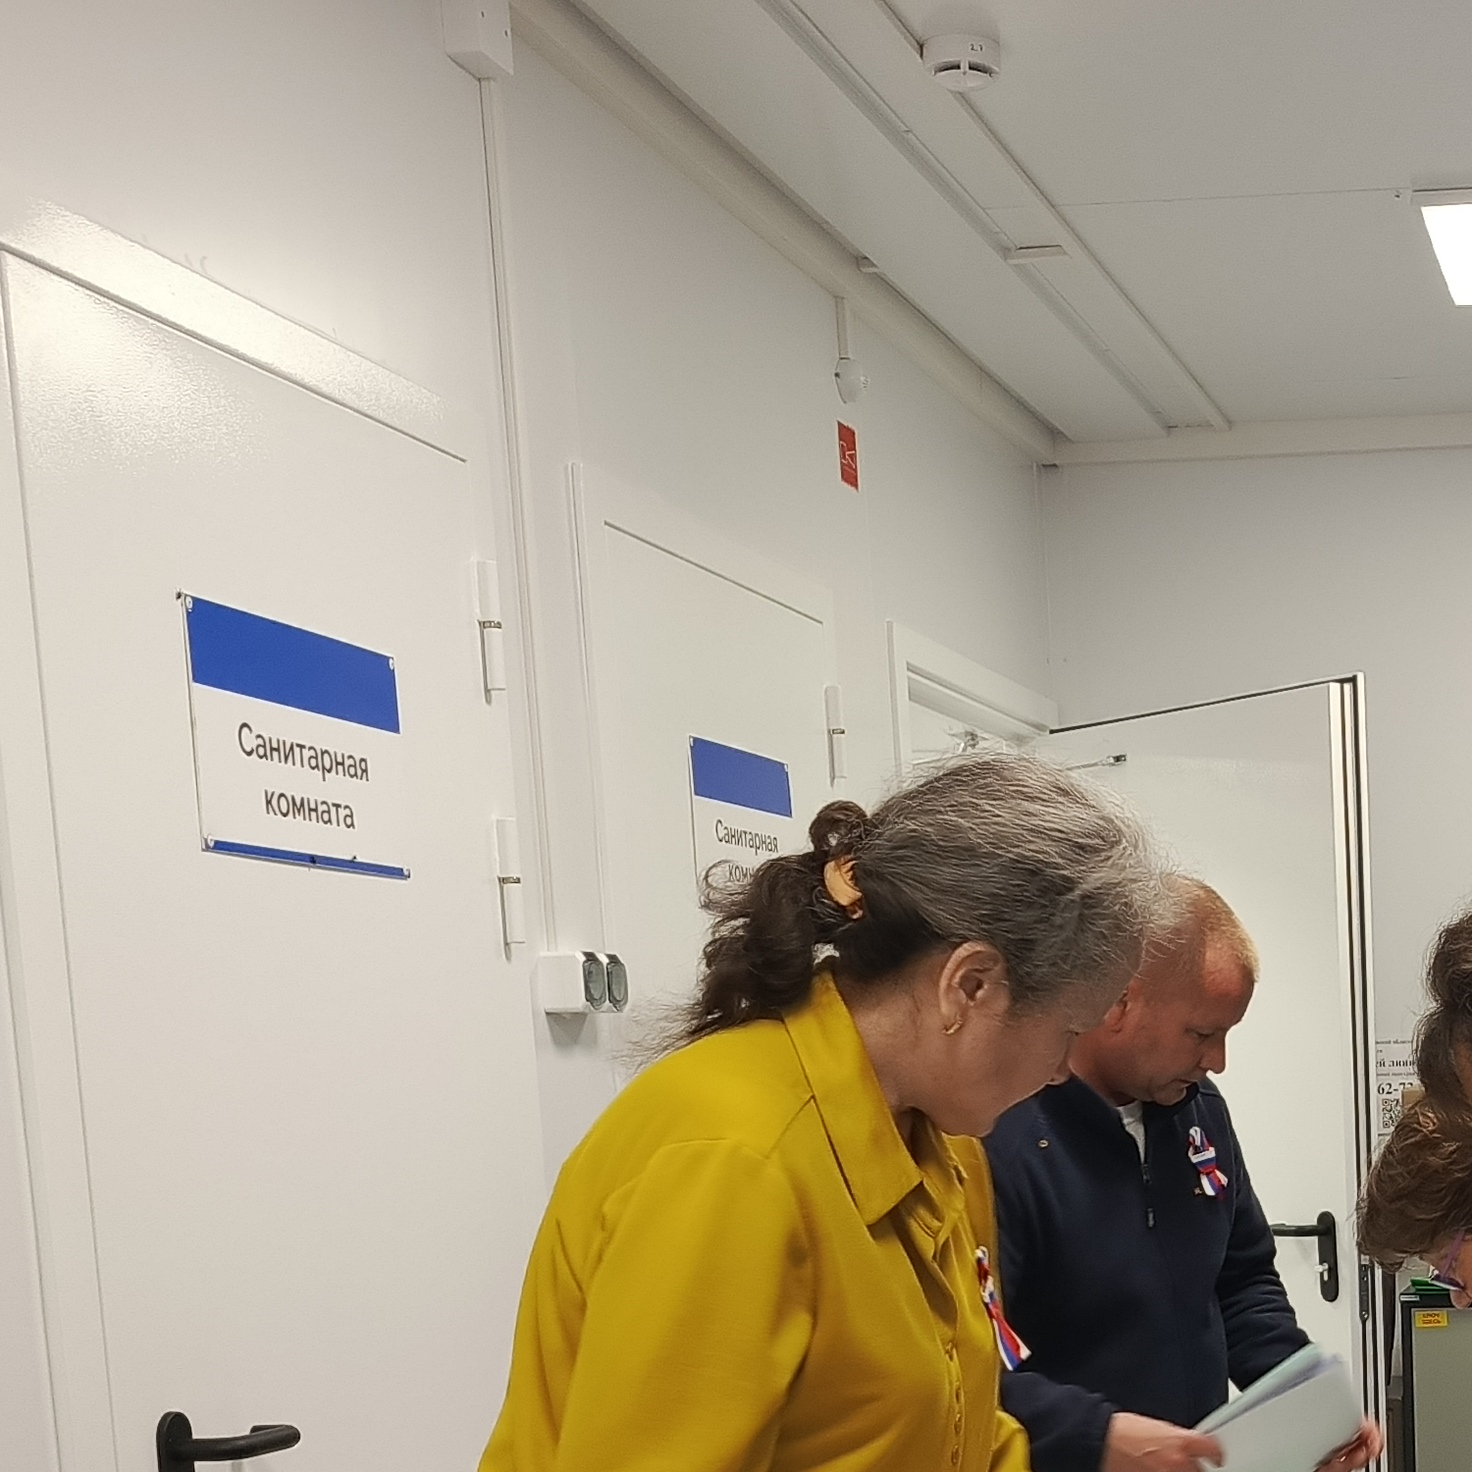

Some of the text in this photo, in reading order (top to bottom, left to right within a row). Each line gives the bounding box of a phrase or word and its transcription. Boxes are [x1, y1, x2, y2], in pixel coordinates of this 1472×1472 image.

[238, 722, 370, 782] Санитарная
[264, 789, 356, 829] комната
[715, 819, 779, 855] Санитарная
[728, 864, 755, 883] комн
